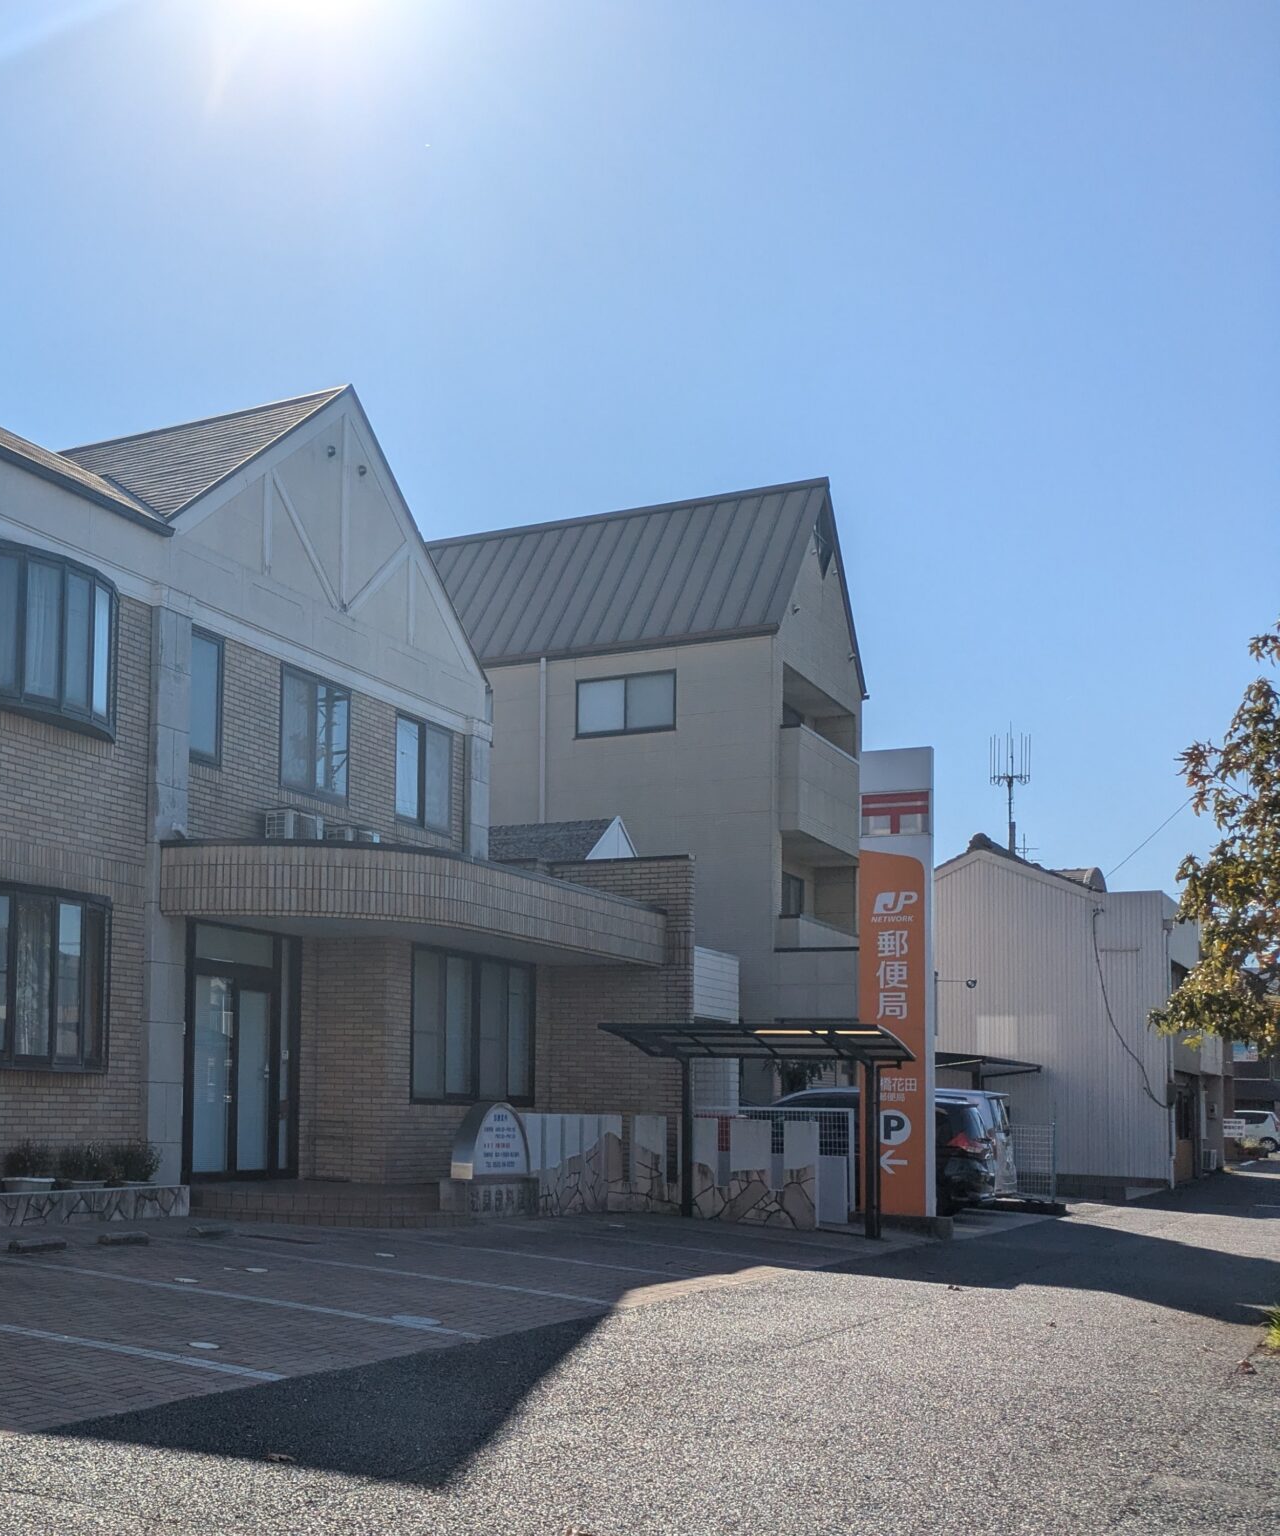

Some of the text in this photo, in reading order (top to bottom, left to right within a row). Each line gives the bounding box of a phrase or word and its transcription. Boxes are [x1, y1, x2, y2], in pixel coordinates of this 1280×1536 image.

[873, 891, 918, 914] JP
[871, 915, 914, 923] NETWORK
[876, 930, 908, 1020] 郵便局
[880, 1076, 917, 1091] 橋花田
[883, 1114, 906, 1141] P
